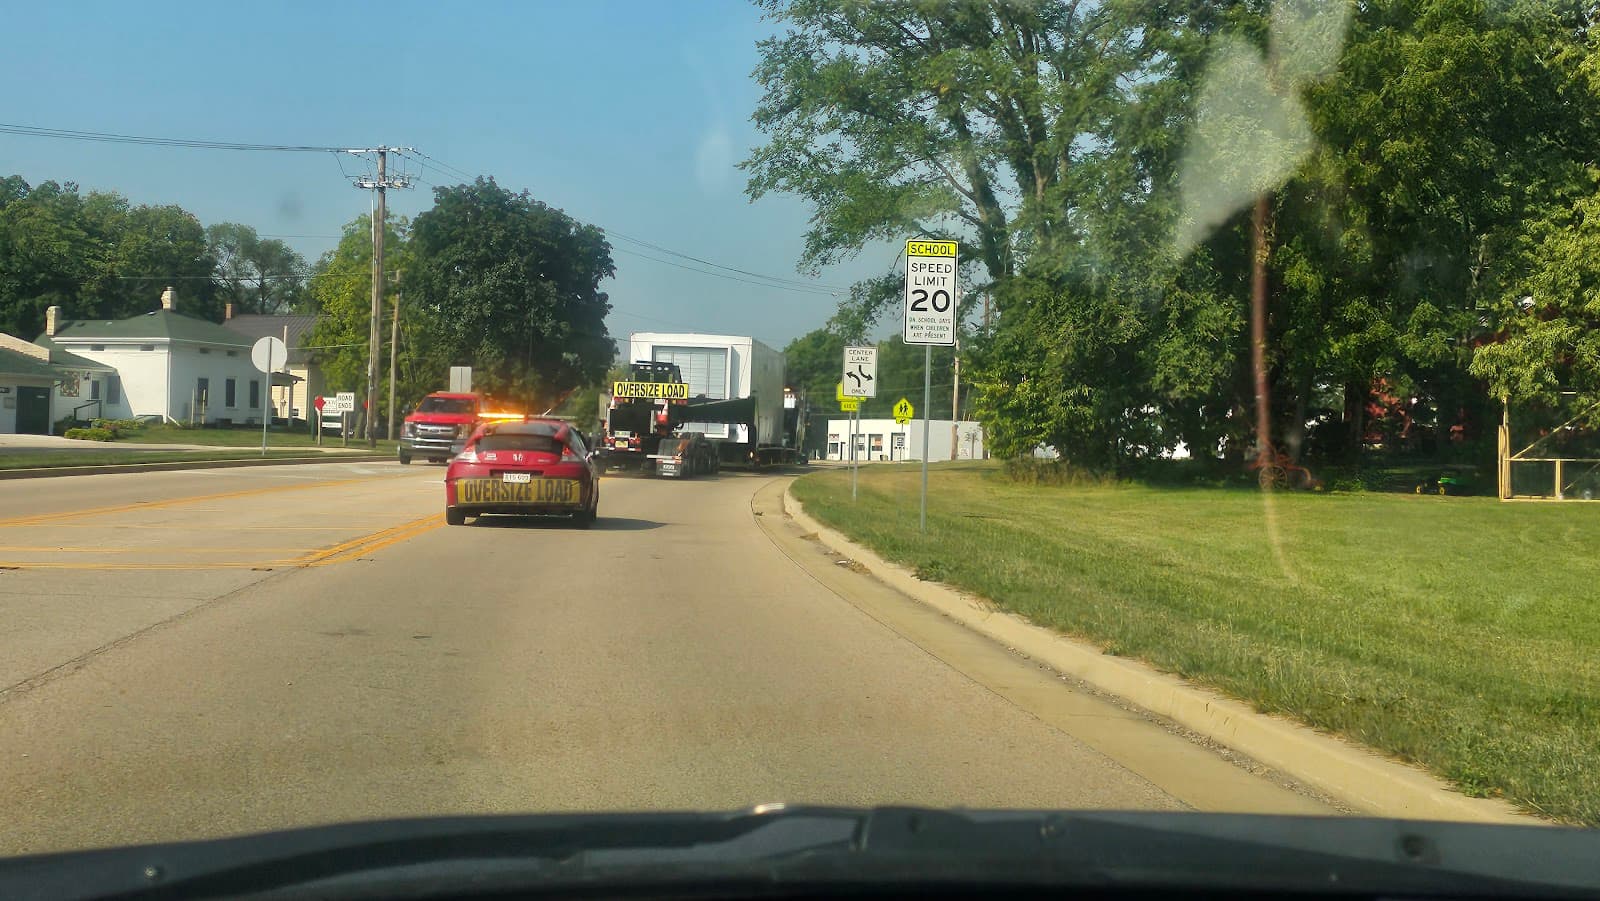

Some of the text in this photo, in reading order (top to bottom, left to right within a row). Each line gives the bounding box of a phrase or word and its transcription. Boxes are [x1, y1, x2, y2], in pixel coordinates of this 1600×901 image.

[910, 244, 953, 255] SCHOOL
[911, 263, 952, 273] SPEED
[914, 276, 947, 287] LIMIT
[910, 289, 950, 312] 20
[617, 383, 685, 398] OVERSIZE LOAD
[464, 479, 573, 502] OVERSIZE LOAD
